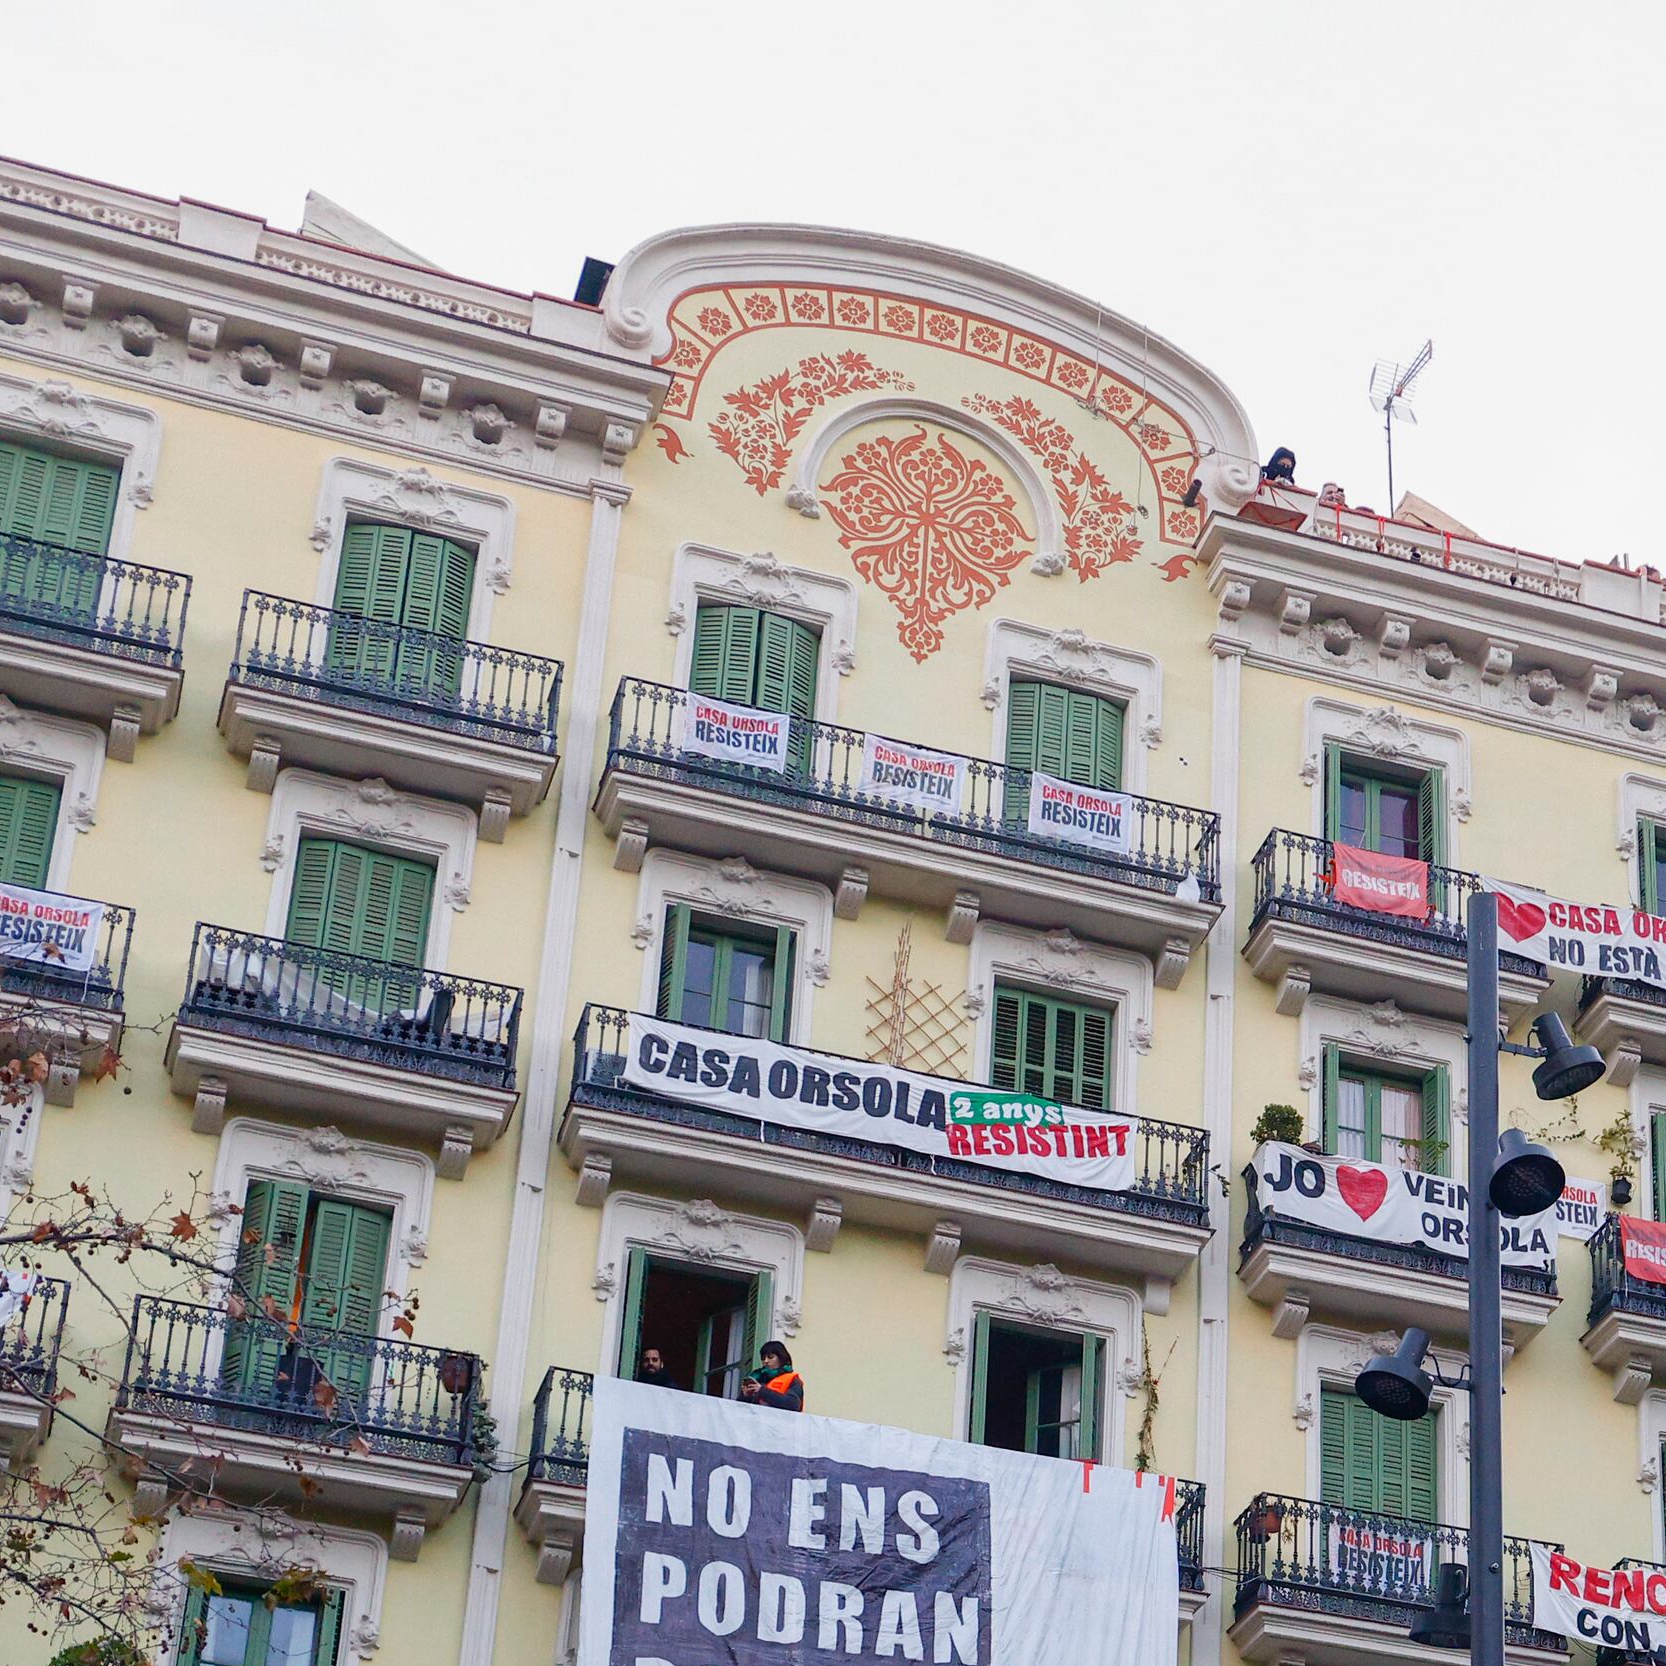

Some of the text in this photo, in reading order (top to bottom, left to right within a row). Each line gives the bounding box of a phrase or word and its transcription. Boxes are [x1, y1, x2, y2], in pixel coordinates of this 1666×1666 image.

[695, 705, 779, 735] CASA ORSOLA
[695, 719, 778, 756] RESISTEIX
[872, 759, 954, 800] RESISTEIX
[874, 745, 955, 778] CASA ORSOLA
[1041, 799, 1121, 838] RESISTEIX
[1042, 784, 1122, 817] CASA ORSOLA
[1342, 868, 1420, 900] RESISTEIX
[34, 905, 90, 928] ORSOLA
[1549, 902, 1622, 936] CASA
[1548, 935, 1586, 967] NO
[1599, 944, 1662, 981] ESTÀ
[638, 1033, 947, 1133] CASA ORSOLA
[952, 1099, 1064, 1129] 2 anys
[946, 1121, 1131, 1160] RESISTINT
[1263, 1153, 1326, 1199] JO
[1421, 1211, 1551, 1254] ORLA
[643, 1454, 941, 1566] NO ENS
[638, 1550, 980, 1666] PODRAN
